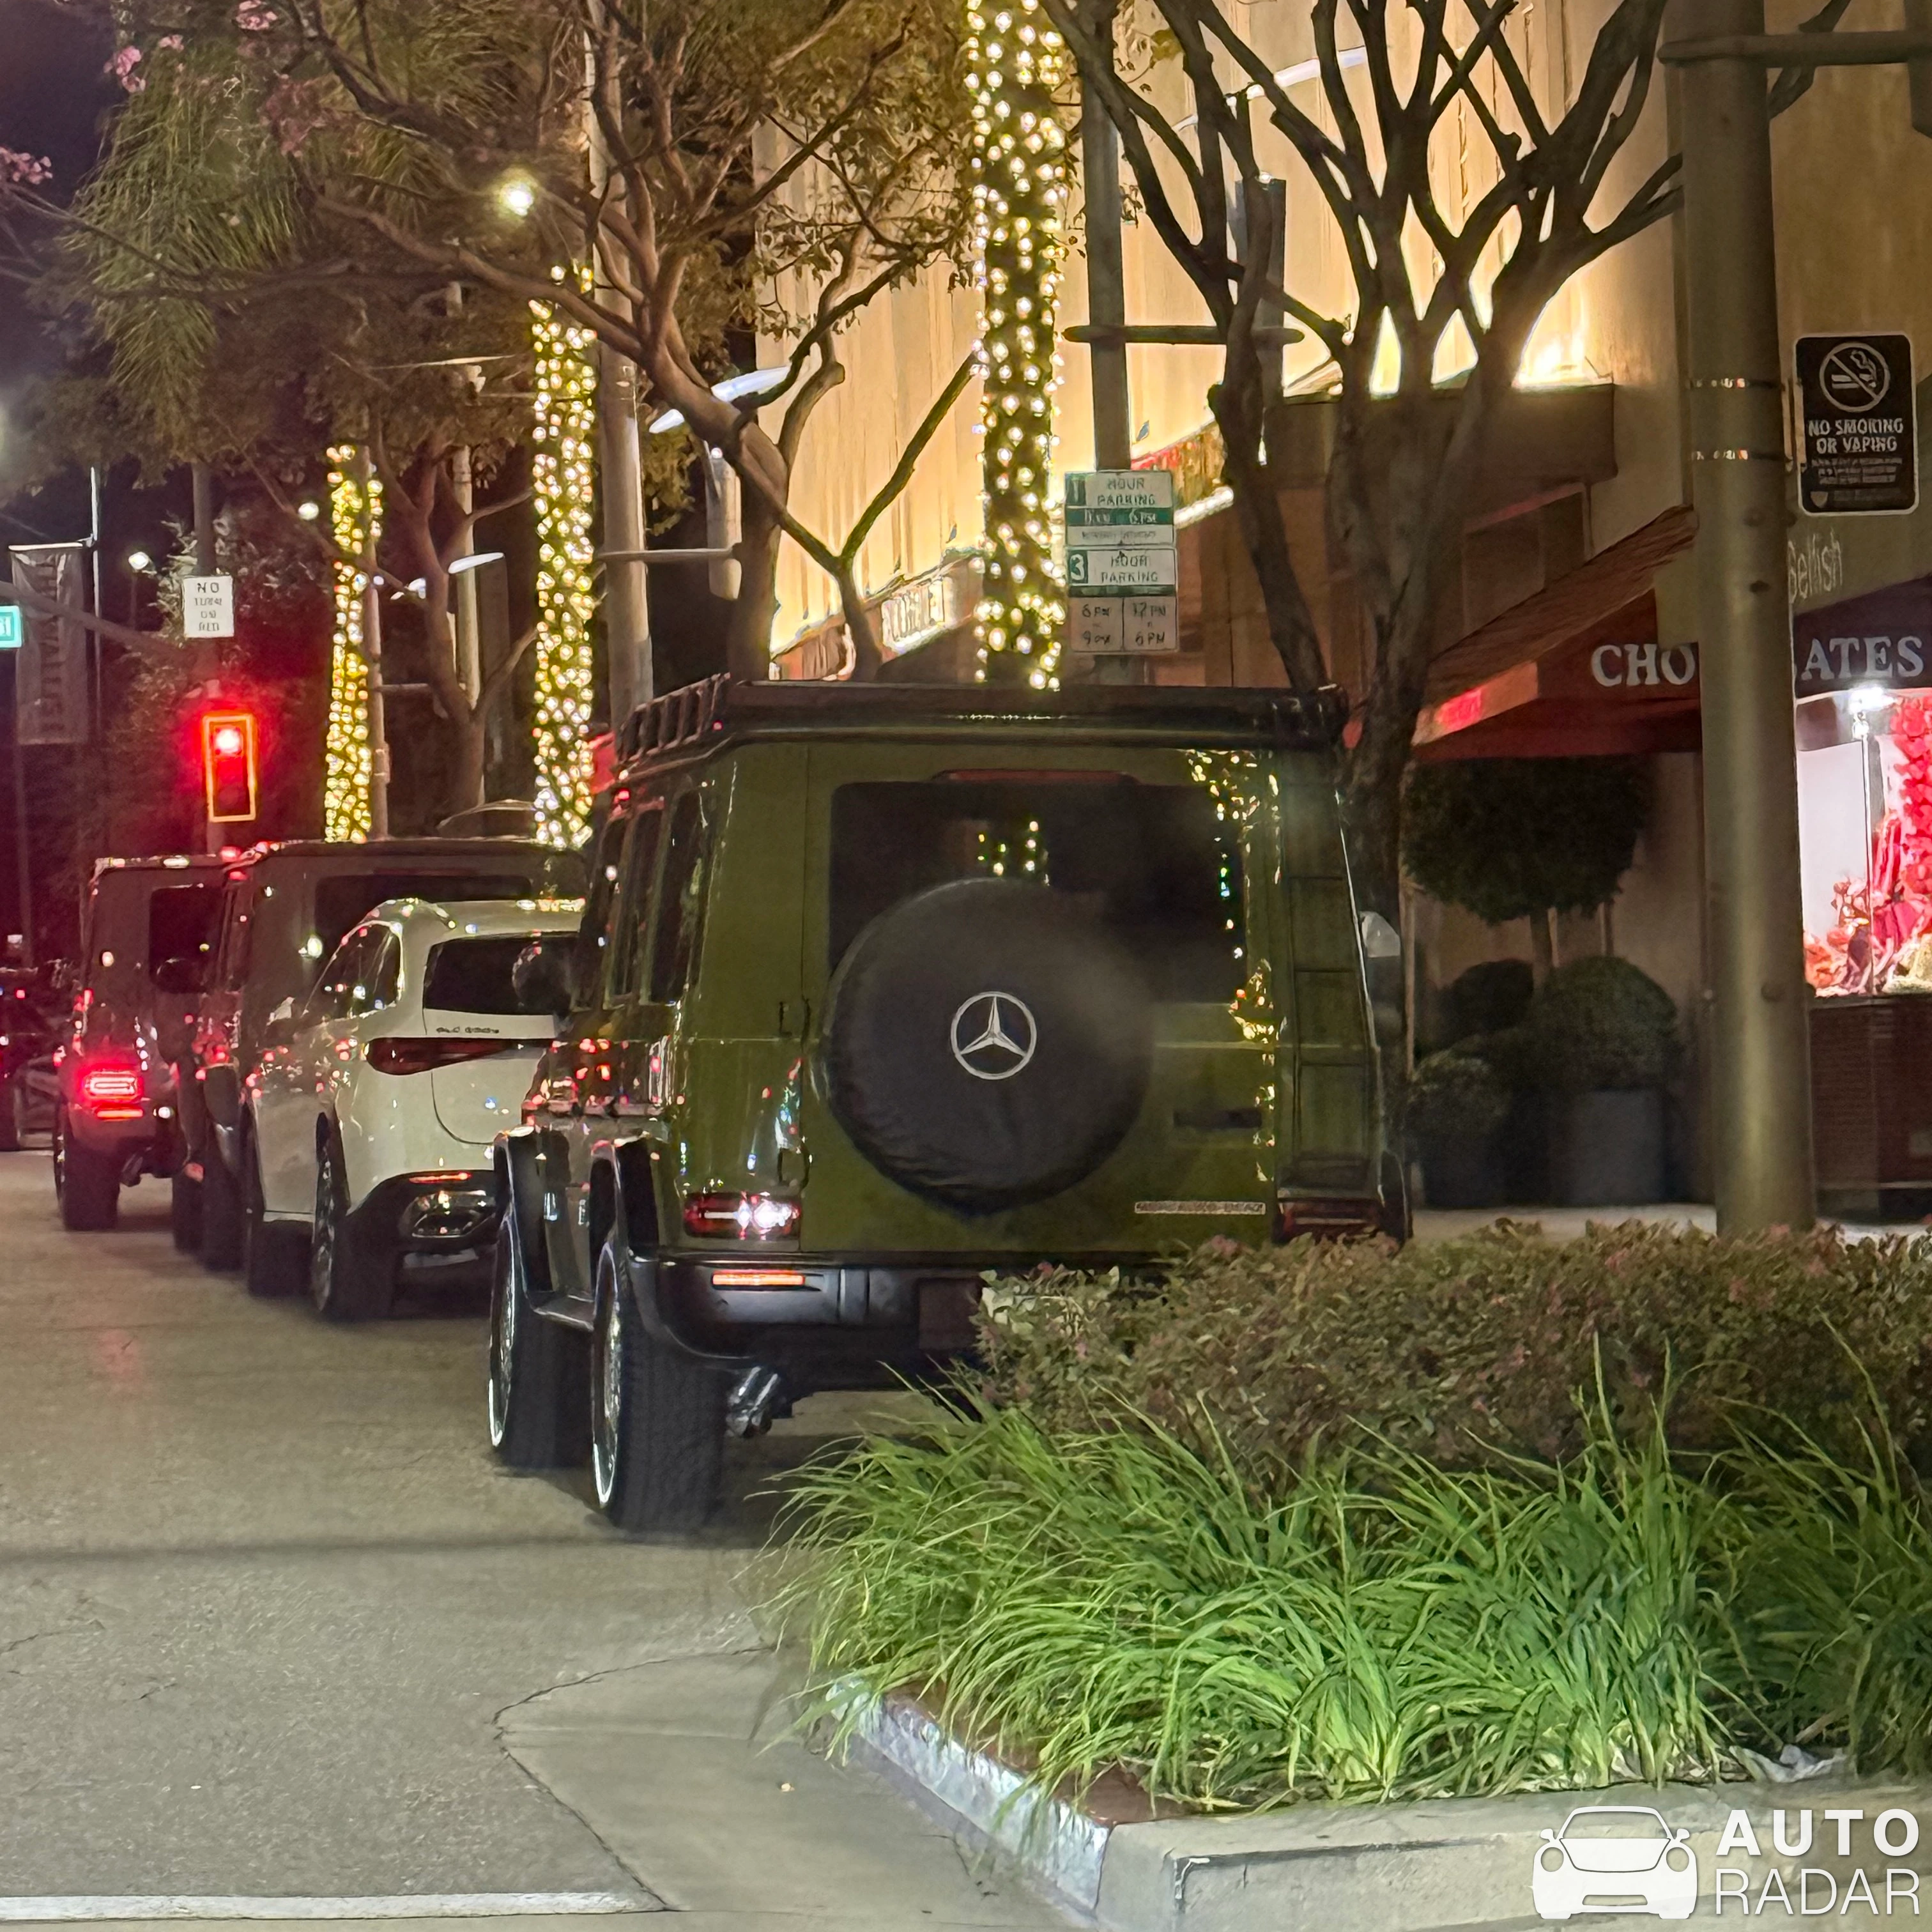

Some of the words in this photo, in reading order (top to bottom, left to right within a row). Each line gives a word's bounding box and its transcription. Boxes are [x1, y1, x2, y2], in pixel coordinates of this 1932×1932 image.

[1808, 419, 1830, 436] NO
[1835, 418, 1904, 435] SMOKING
[1816, 438, 1837, 454] OR
[1843, 436, 1897, 452] VAPING
[1107, 478, 1145, 489] HOUR
[1098, 494, 1155, 505] PARKING
[1070, 554, 1084, 580] 3
[1111, 555, 1148, 567] HOUR
[1101, 572, 1158, 583] PARKING
[197, 582, 219, 593] NO
[1591, 636, 1924, 687] CHOATES
